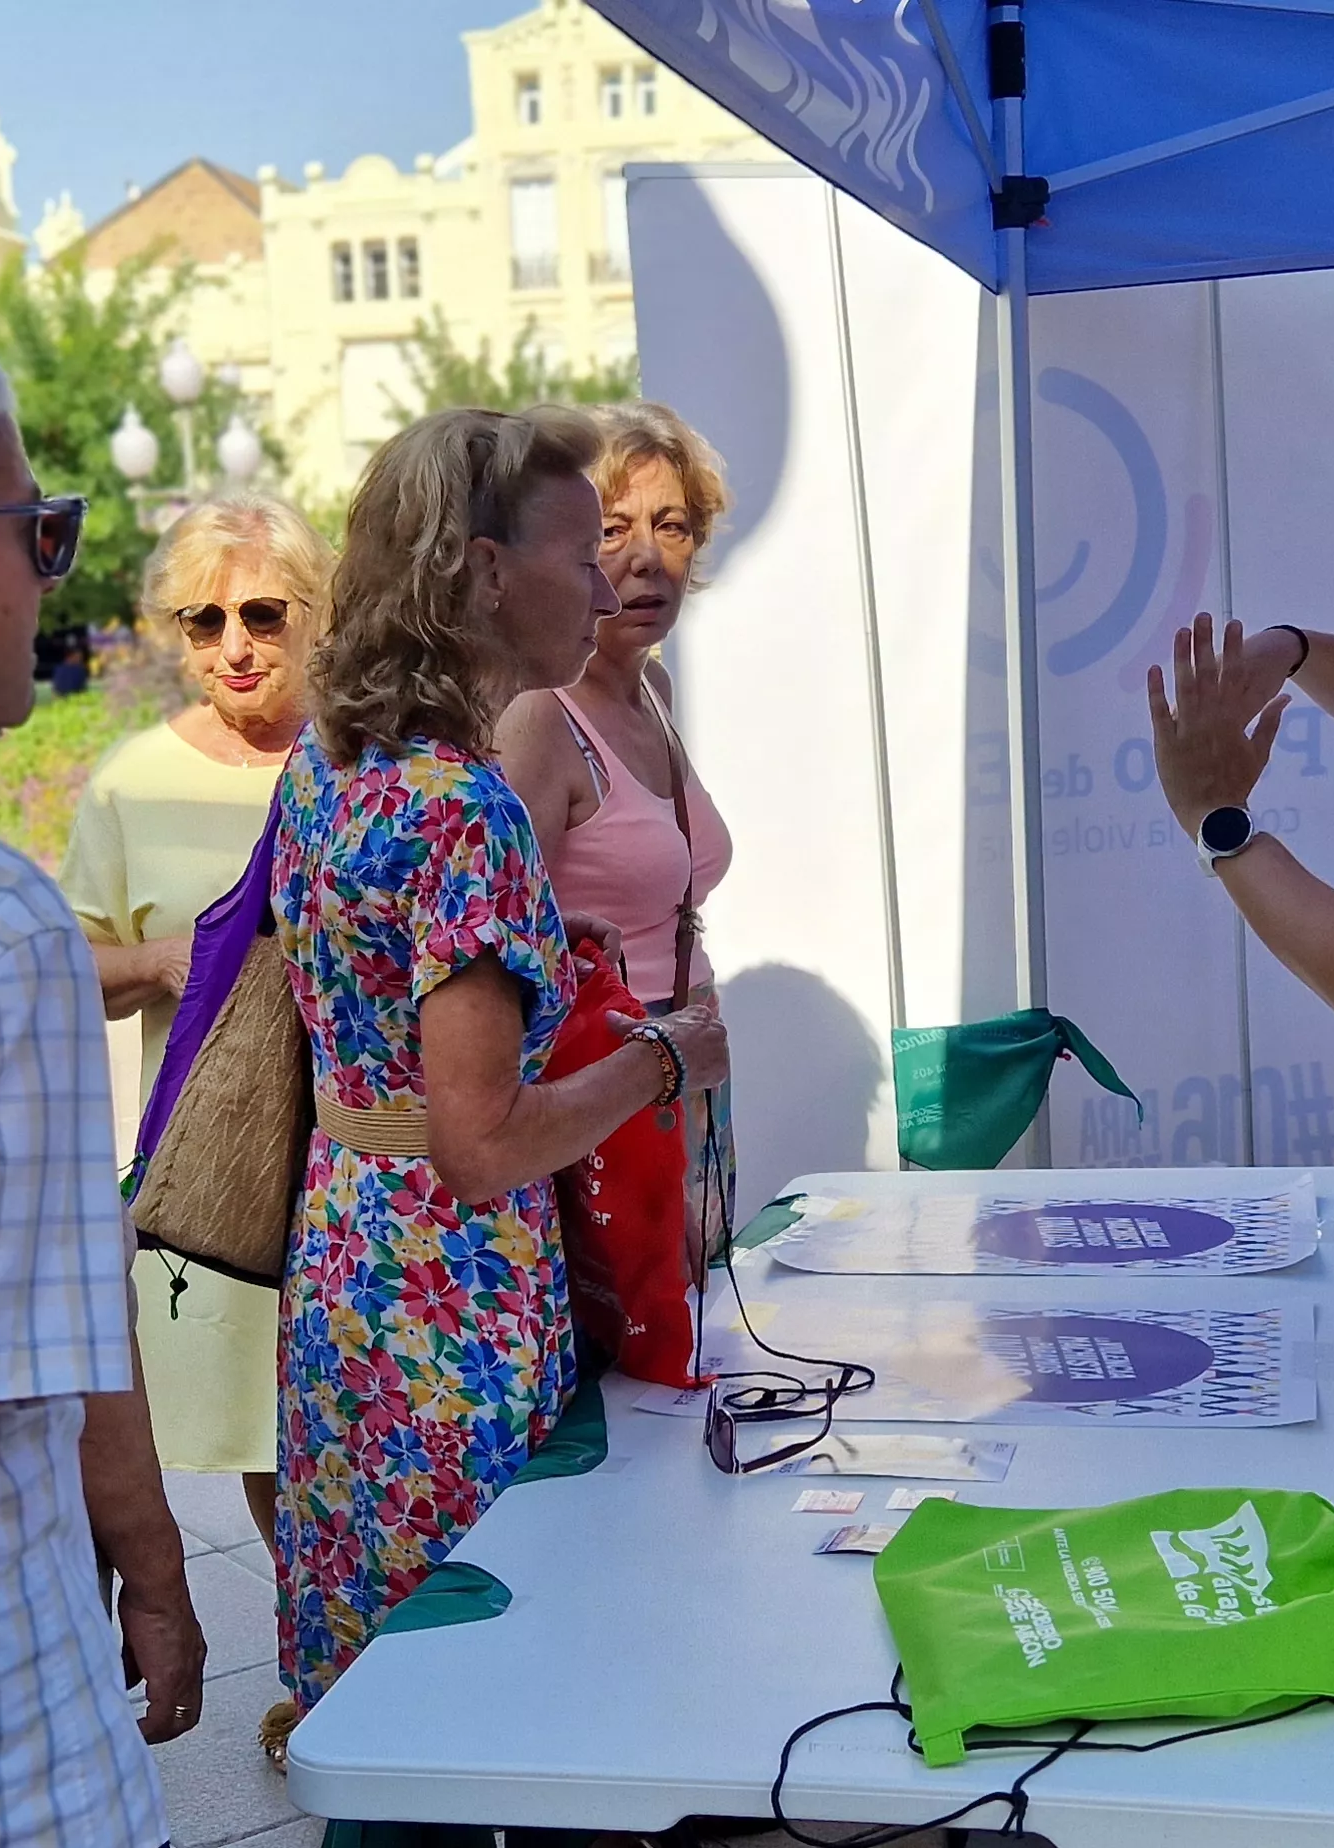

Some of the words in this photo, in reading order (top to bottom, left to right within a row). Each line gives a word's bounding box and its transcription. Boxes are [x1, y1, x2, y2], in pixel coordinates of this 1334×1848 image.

[1034, 1216, 1084, 1248] UNIDAS
[1056, 1335, 1105, 1380] MACHISTA
[1052, 1527, 1069, 1549] ANTE
[1058, 1549, 1071, 1560] LA
[1174, 1580, 1203, 1601] de
